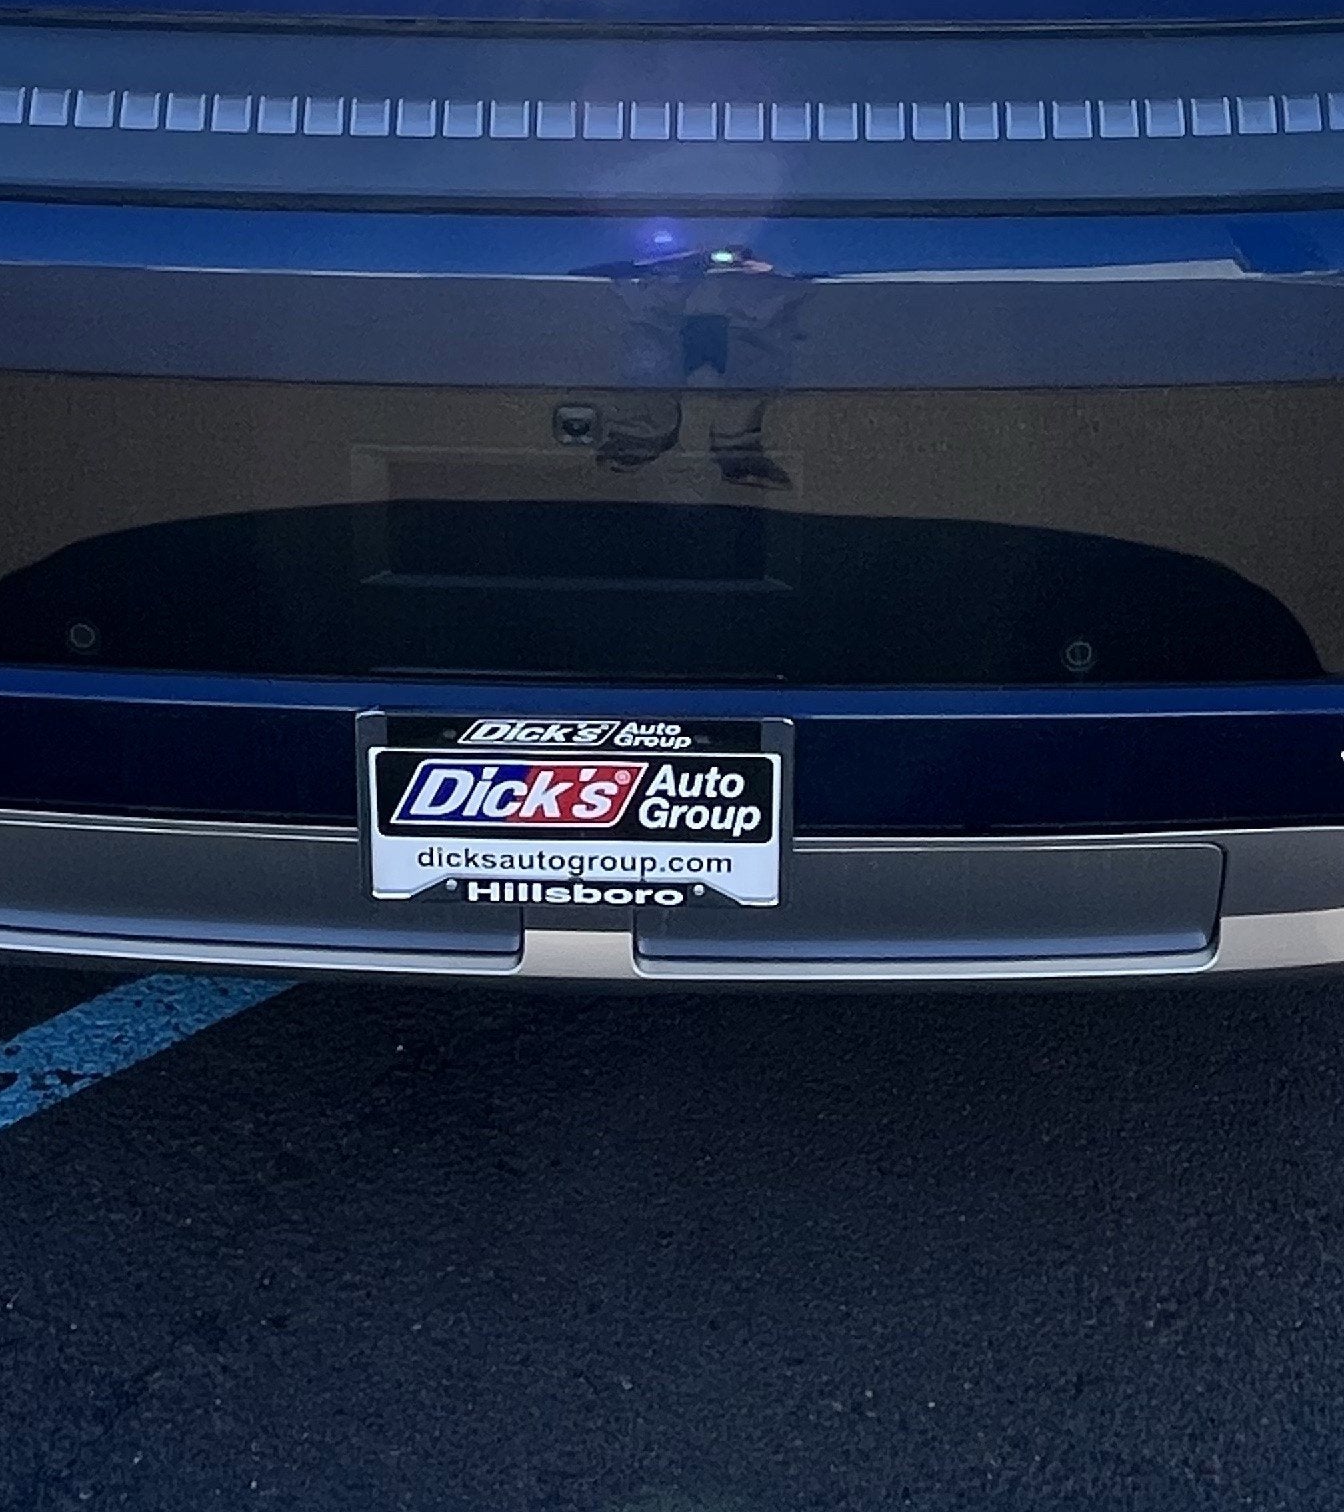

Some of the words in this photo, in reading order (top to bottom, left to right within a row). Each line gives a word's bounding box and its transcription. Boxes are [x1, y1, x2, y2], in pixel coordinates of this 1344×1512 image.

[469, 722, 609, 743] Dick's
[613, 735, 692, 750] Group
[623, 722, 682, 736] Auto
[409, 767, 619, 819] Dick's
[645, 764, 745, 799] Auto
[638, 798, 761, 838] Group
[417, 846, 733, 878] dicksautogroup.com
[467, 881, 684, 906] Hillsboro
